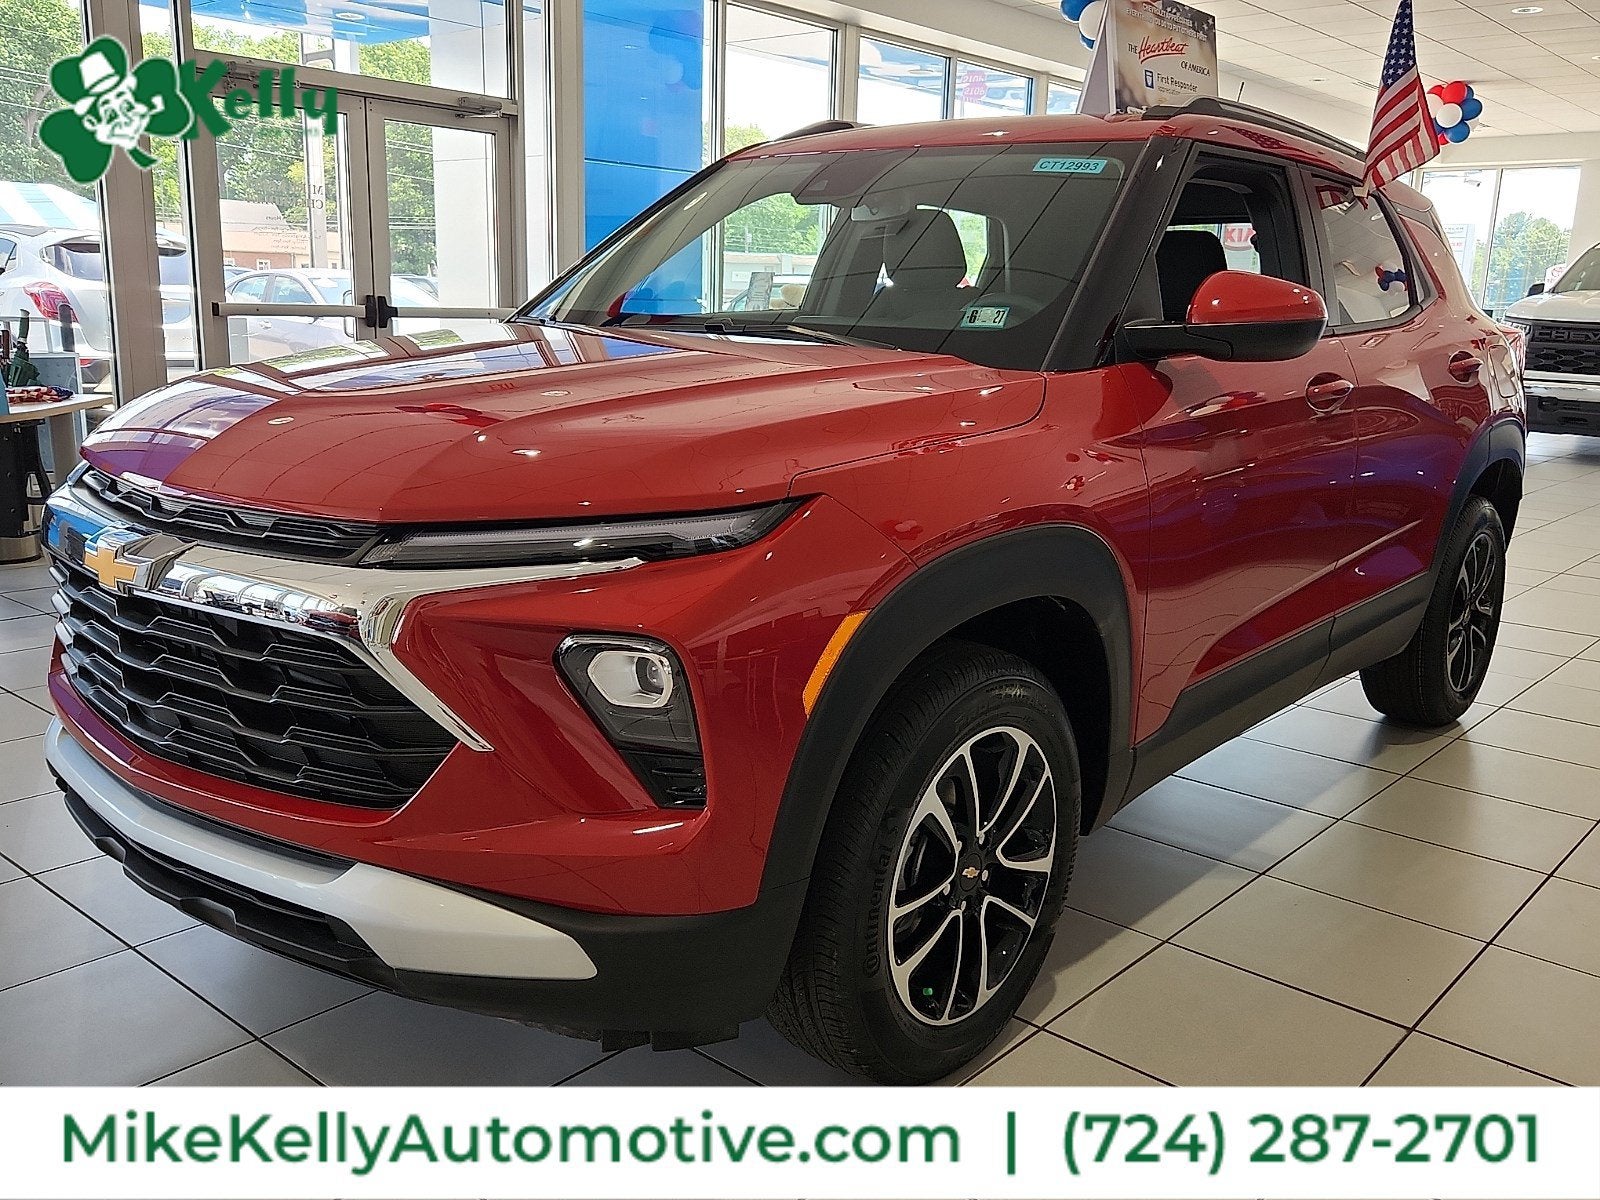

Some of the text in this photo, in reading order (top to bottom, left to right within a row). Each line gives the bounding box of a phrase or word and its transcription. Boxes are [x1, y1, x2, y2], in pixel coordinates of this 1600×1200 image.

[1128, 35, 1189, 60] THE Heartbeat
[1181, 60, 1211, 76] OF AMERICA
[1157, 73, 1198, 92] First Responder
[1039, 160, 1100, 172] CT12993
[1225, 227, 1254, 243] KIA
[992, 309, 1006, 325] 27
